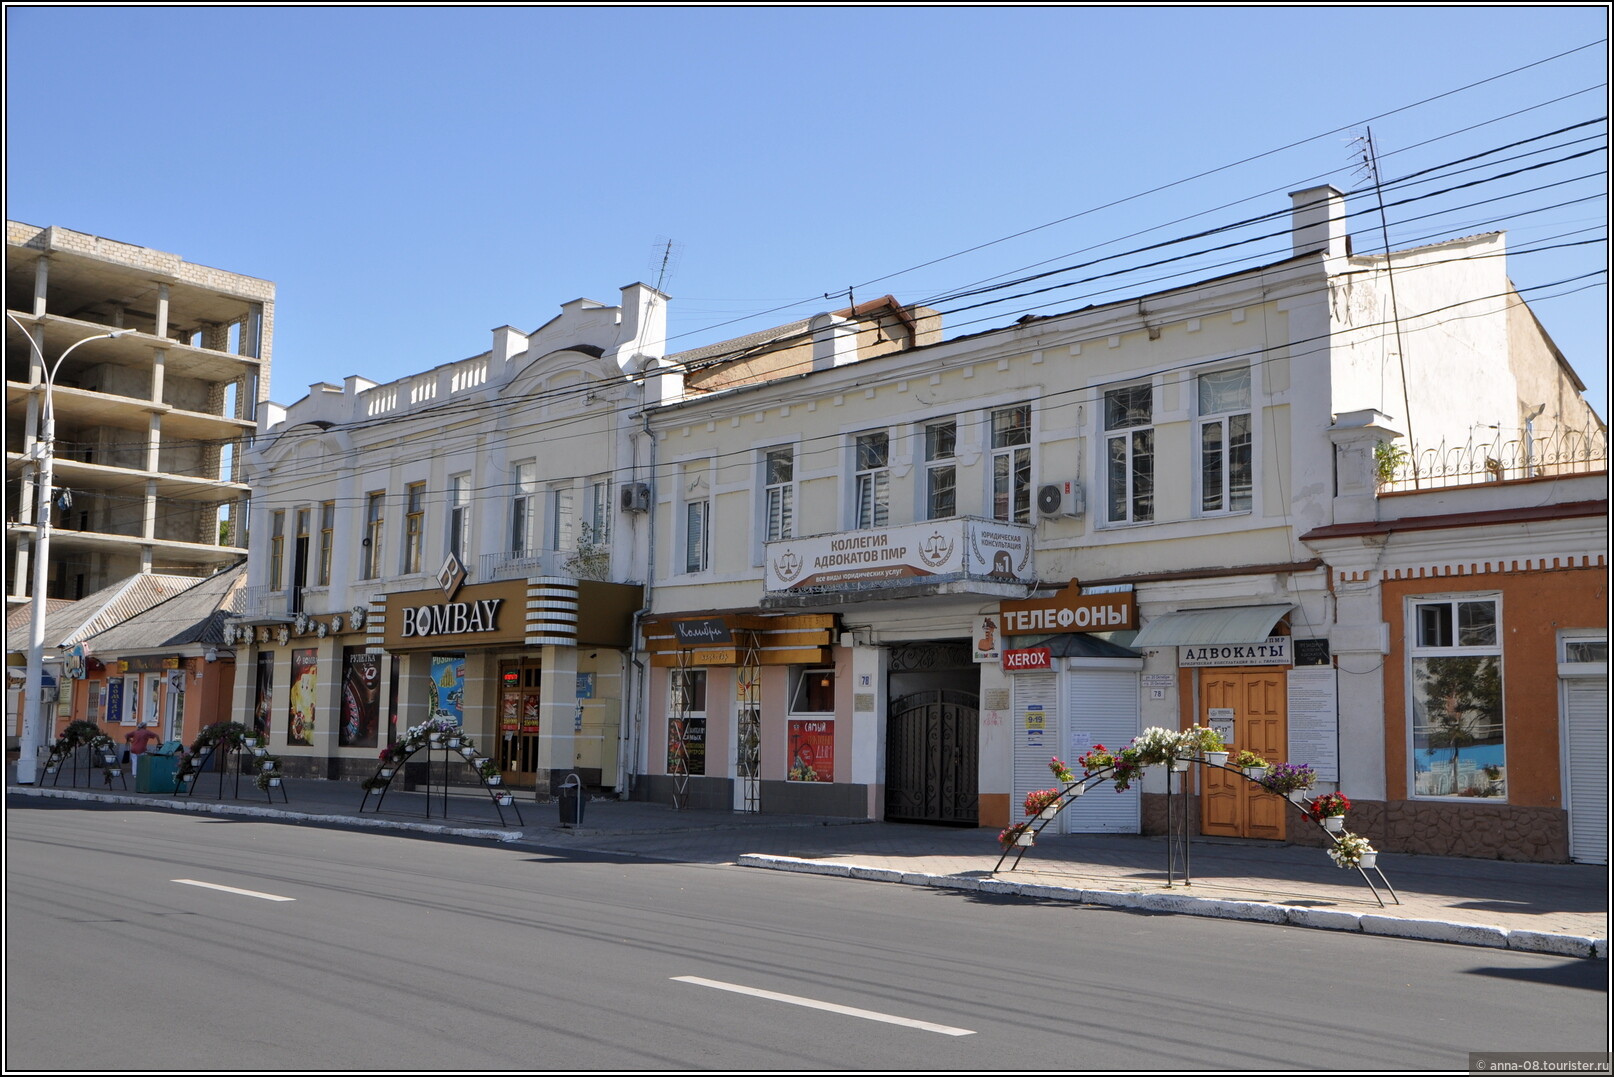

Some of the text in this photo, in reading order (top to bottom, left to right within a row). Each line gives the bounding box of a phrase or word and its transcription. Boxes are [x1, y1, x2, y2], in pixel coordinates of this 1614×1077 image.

[830, 534, 888, 552] КОЛЛЕГИЯ
[980, 531, 1022, 542] ЮРИДИЧЕСКАЯ
[981, 539, 1022, 551] КОНСУЛЬТАЦИЯ
[814, 546, 907, 569] АДВОКАТОВ ПМР
[815, 568, 903, 583] все виды юридических услуг
[401, 599, 500, 637] BOMBAY
[1003, 604, 1127, 630] ТЕЛЕФОНЫ
[678, 622, 722, 641] Колибри
[349, 654, 376, 663] РУЛЕТКА
[1007, 653, 1046, 667] XEROX
[1186, 646, 1284, 660] АДВОКАТЫ
[861, 676, 870, 686] 78
[804, 722, 827, 733] САМЫЙ
